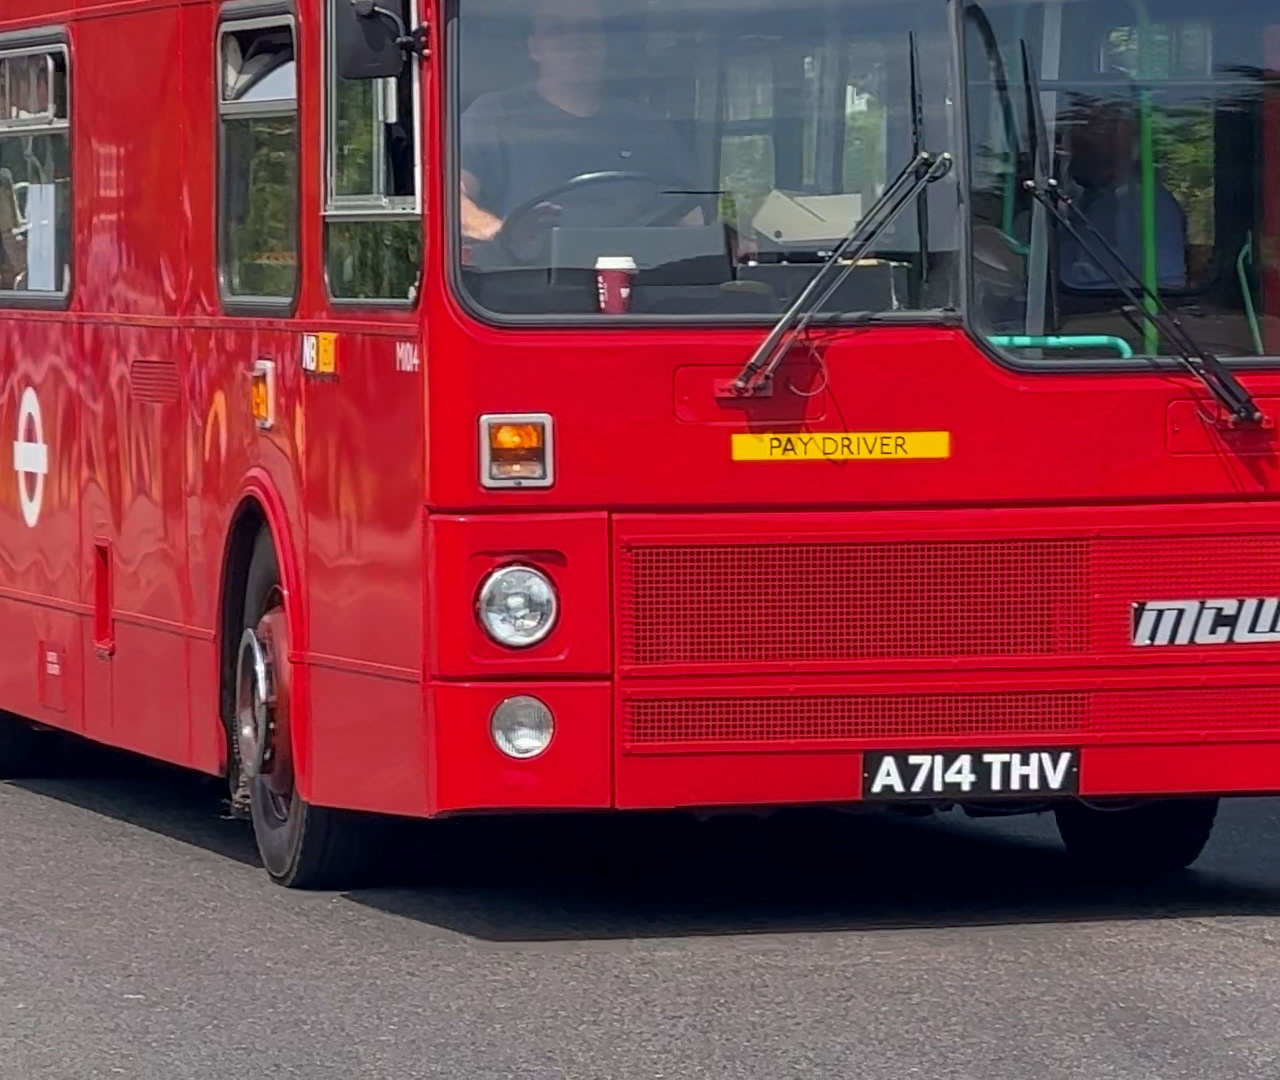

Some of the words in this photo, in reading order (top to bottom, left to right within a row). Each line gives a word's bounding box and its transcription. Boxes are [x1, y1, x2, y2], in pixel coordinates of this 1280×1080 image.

[769, 437, 814, 456] PAY
[822, 436, 908, 456] DRIVER
[870, 754, 976, 794] A714
[982, 751, 1071, 791] THV
